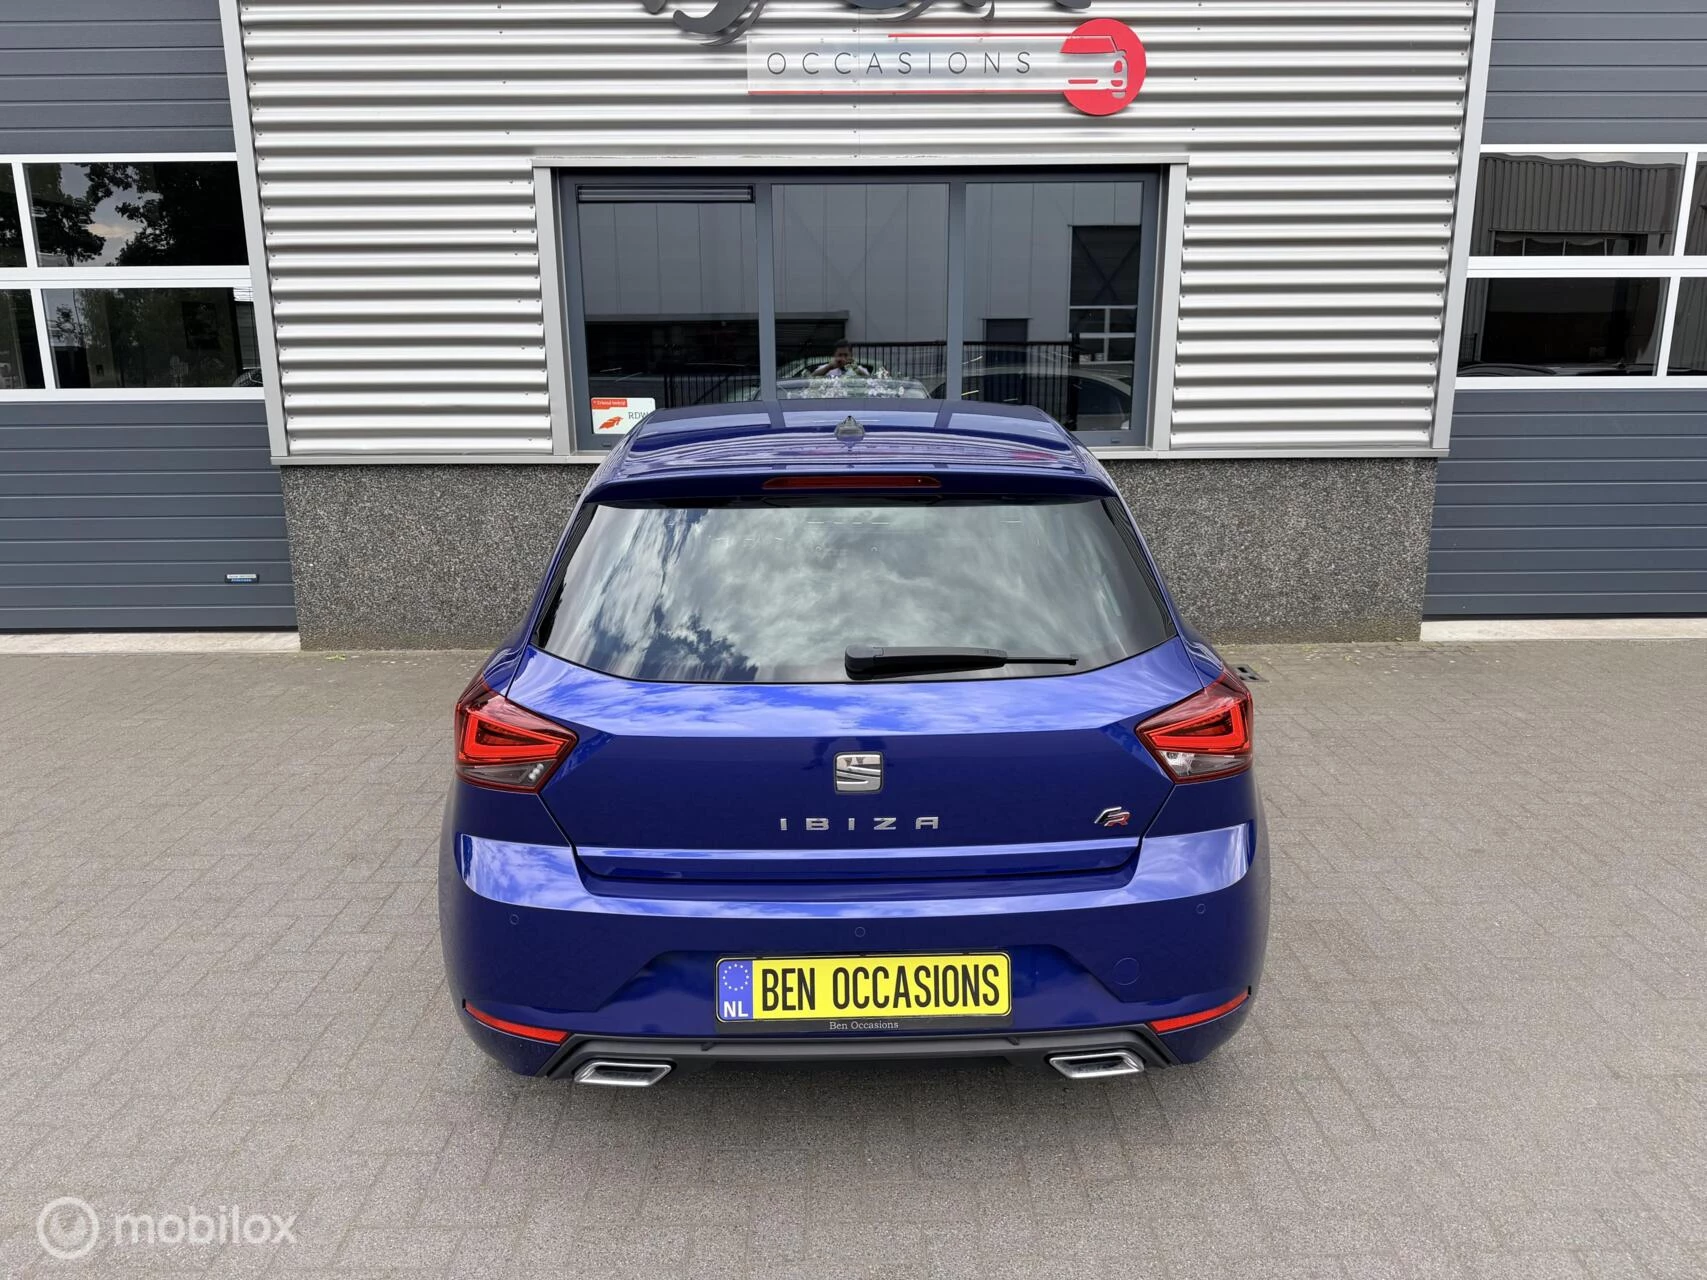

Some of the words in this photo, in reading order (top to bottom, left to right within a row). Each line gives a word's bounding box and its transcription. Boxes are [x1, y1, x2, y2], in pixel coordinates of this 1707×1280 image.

[766, 51, 1032, 75] OCCASIONS
[779, 816, 939, 831] IBIZA
[761, 967, 816, 1012] BEN
[832, 964, 1000, 1010] OCCASIONS
[723, 1001, 749, 1018] NL
[829, 1021, 848, 1030] Ben
[850, 1020, 899, 1030] Occasions
